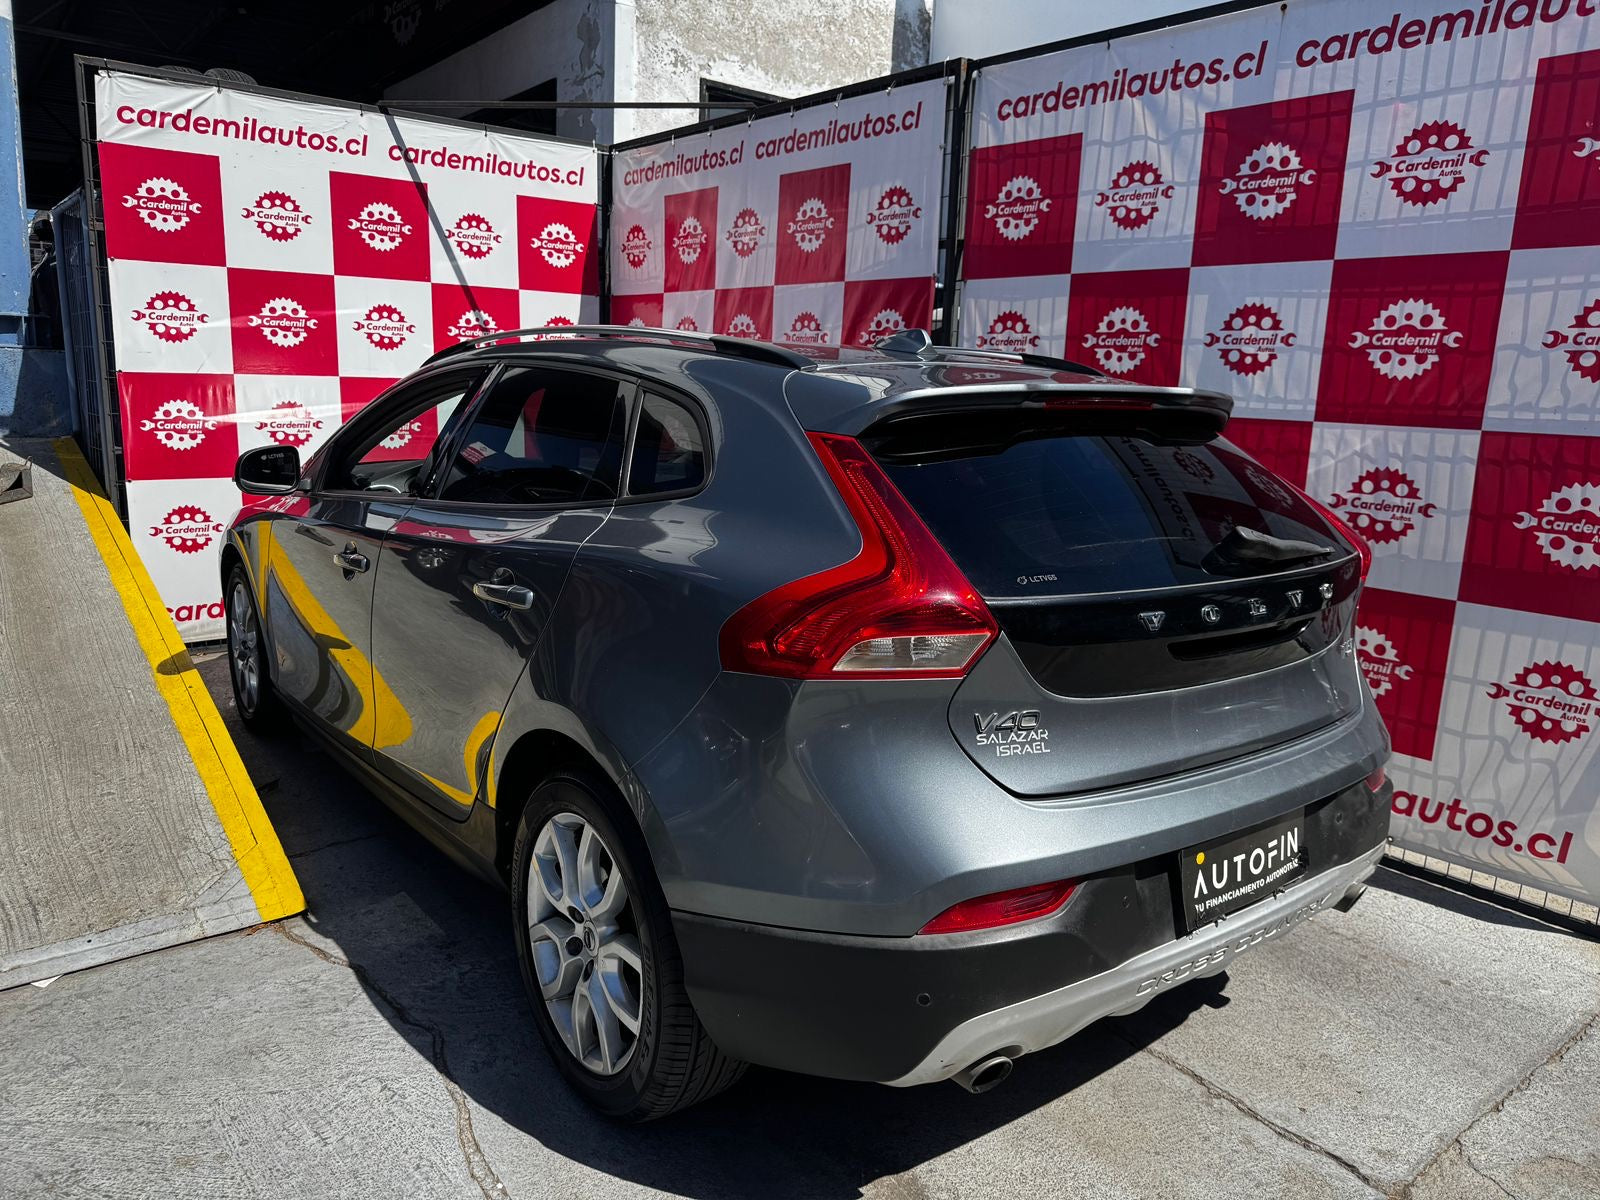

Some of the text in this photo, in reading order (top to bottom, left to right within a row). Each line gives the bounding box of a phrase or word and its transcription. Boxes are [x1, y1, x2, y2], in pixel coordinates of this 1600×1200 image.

[997, 40, 1268, 122] cardemilautos.cl
[116, 105, 368, 156] cardemilautos.cl
[755, 101, 922, 160] cardemilautos.cl
[388, 144, 584, 186] cardemilautos.cl
[624, 140, 744, 186] cardemilautos.cl
[1394, 154, 1466, 173] Cardemil
[1438, 168, 1462, 178] Autos
[1238, 172, 1297, 190] Cardemil
[1111, 188, 1158, 203] Cardemil
[140, 198, 187, 212] Cardemil
[998, 202, 1038, 215] Cardemil
[257, 210, 300, 222] Cardemil
[878, 209, 912, 222] Cardemil
[362, 221, 400, 232] Cardemil
[797, 220, 825, 231] Cardemil
[456, 231, 492, 242] Cardemil
[734, 230, 758, 240] Cardemil
[542, 240, 574, 250] Cardemil
[149, 311, 195, 322] Cardemil
[262, 316, 305, 328] Cardemil
[366, 323, 404, 332] Cardemil
[792, 334, 819, 343] Cardemil
[989, 336, 1028, 346] Cardemil
[1098, 332, 1144, 346] Cardemil
[1222, 333, 1278, 346] Cardemil
[1372, 332, 1442, 346] Cardemil
[1413, 346, 1436, 354] Autos
[156, 420, 203, 431] Cardemil
[270, 420, 310, 430] Cardemil
[1350, 497, 1415, 516] Cardemil
[1390, 513, 1412, 522] Autos
[166, 524, 210, 534] Cardemil
[1137, 583, 1334, 632] VOLVO
[1368, 672, 1389, 682] Autos
[1514, 690, 1592, 716] Cardemil
[973, 710, 1042, 734] V40
[1560, 712, 1586, 724] Autos
[976, 728, 1049, 746] SALAZAR
[996, 742, 1050, 757] ISRAEL
[1194, 827, 1298, 898] AUTOFIN
[1206, 879, 1265, 909] FINANCIAMIENTO
